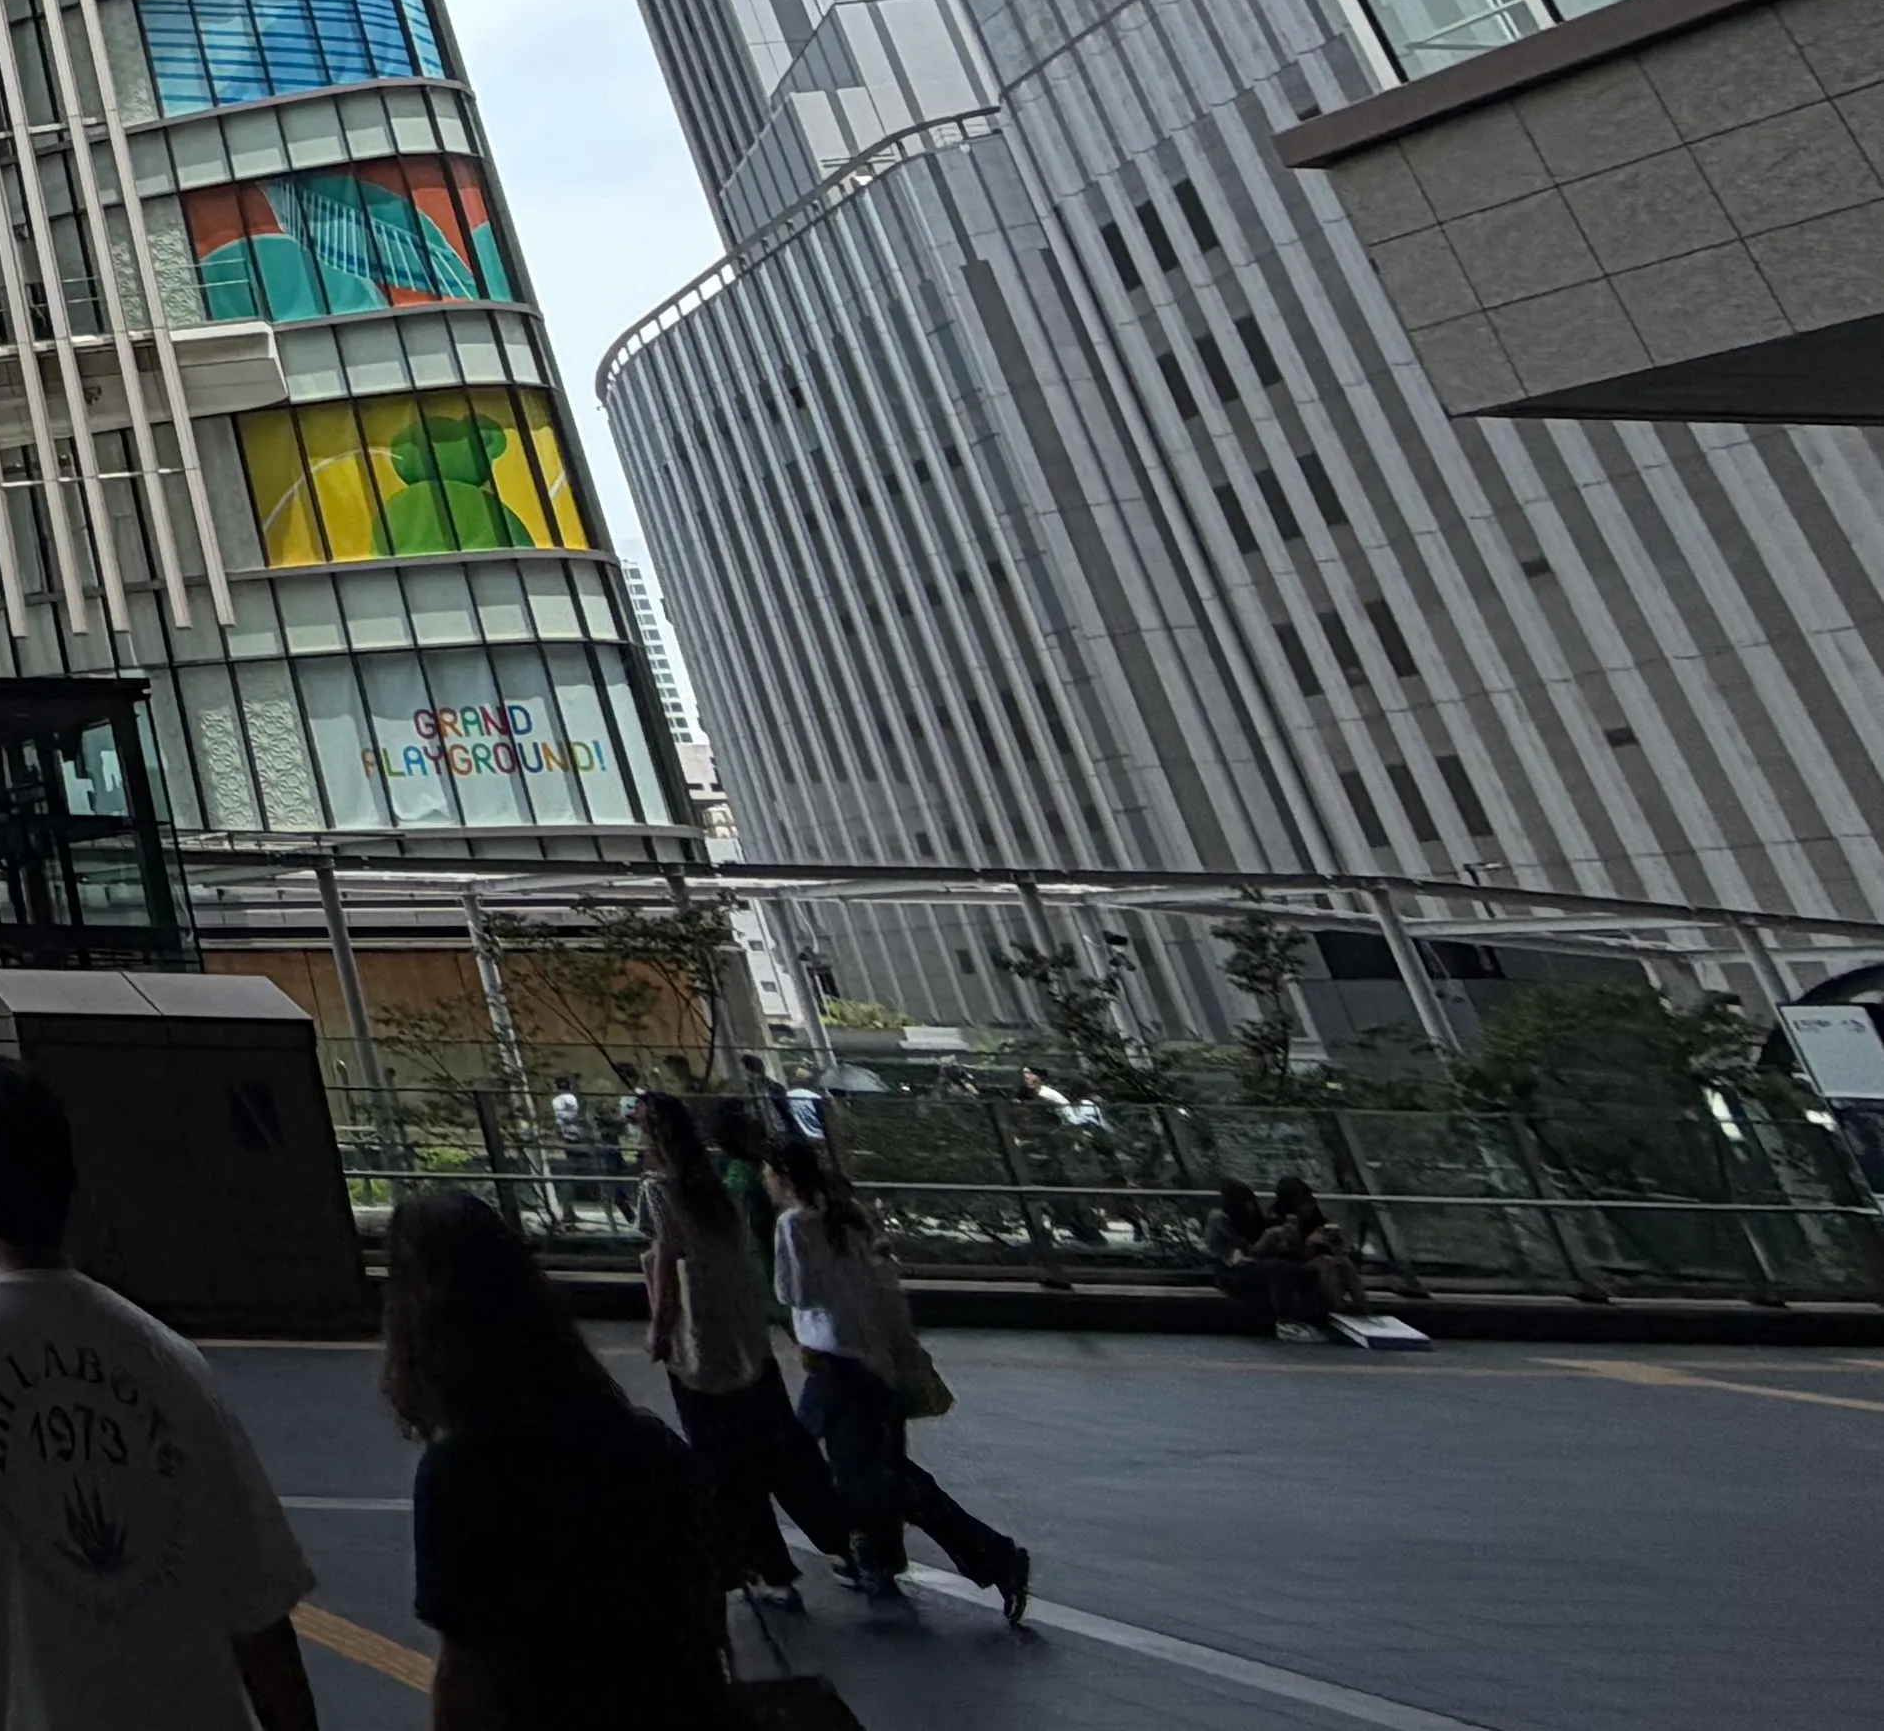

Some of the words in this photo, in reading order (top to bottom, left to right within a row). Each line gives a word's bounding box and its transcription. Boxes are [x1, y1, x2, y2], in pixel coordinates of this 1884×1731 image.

[413, 704, 533, 739] GRAND
[361, 740, 606, 777] PLAYGROUND!
[29, 1401, 129, 1466] 1973
